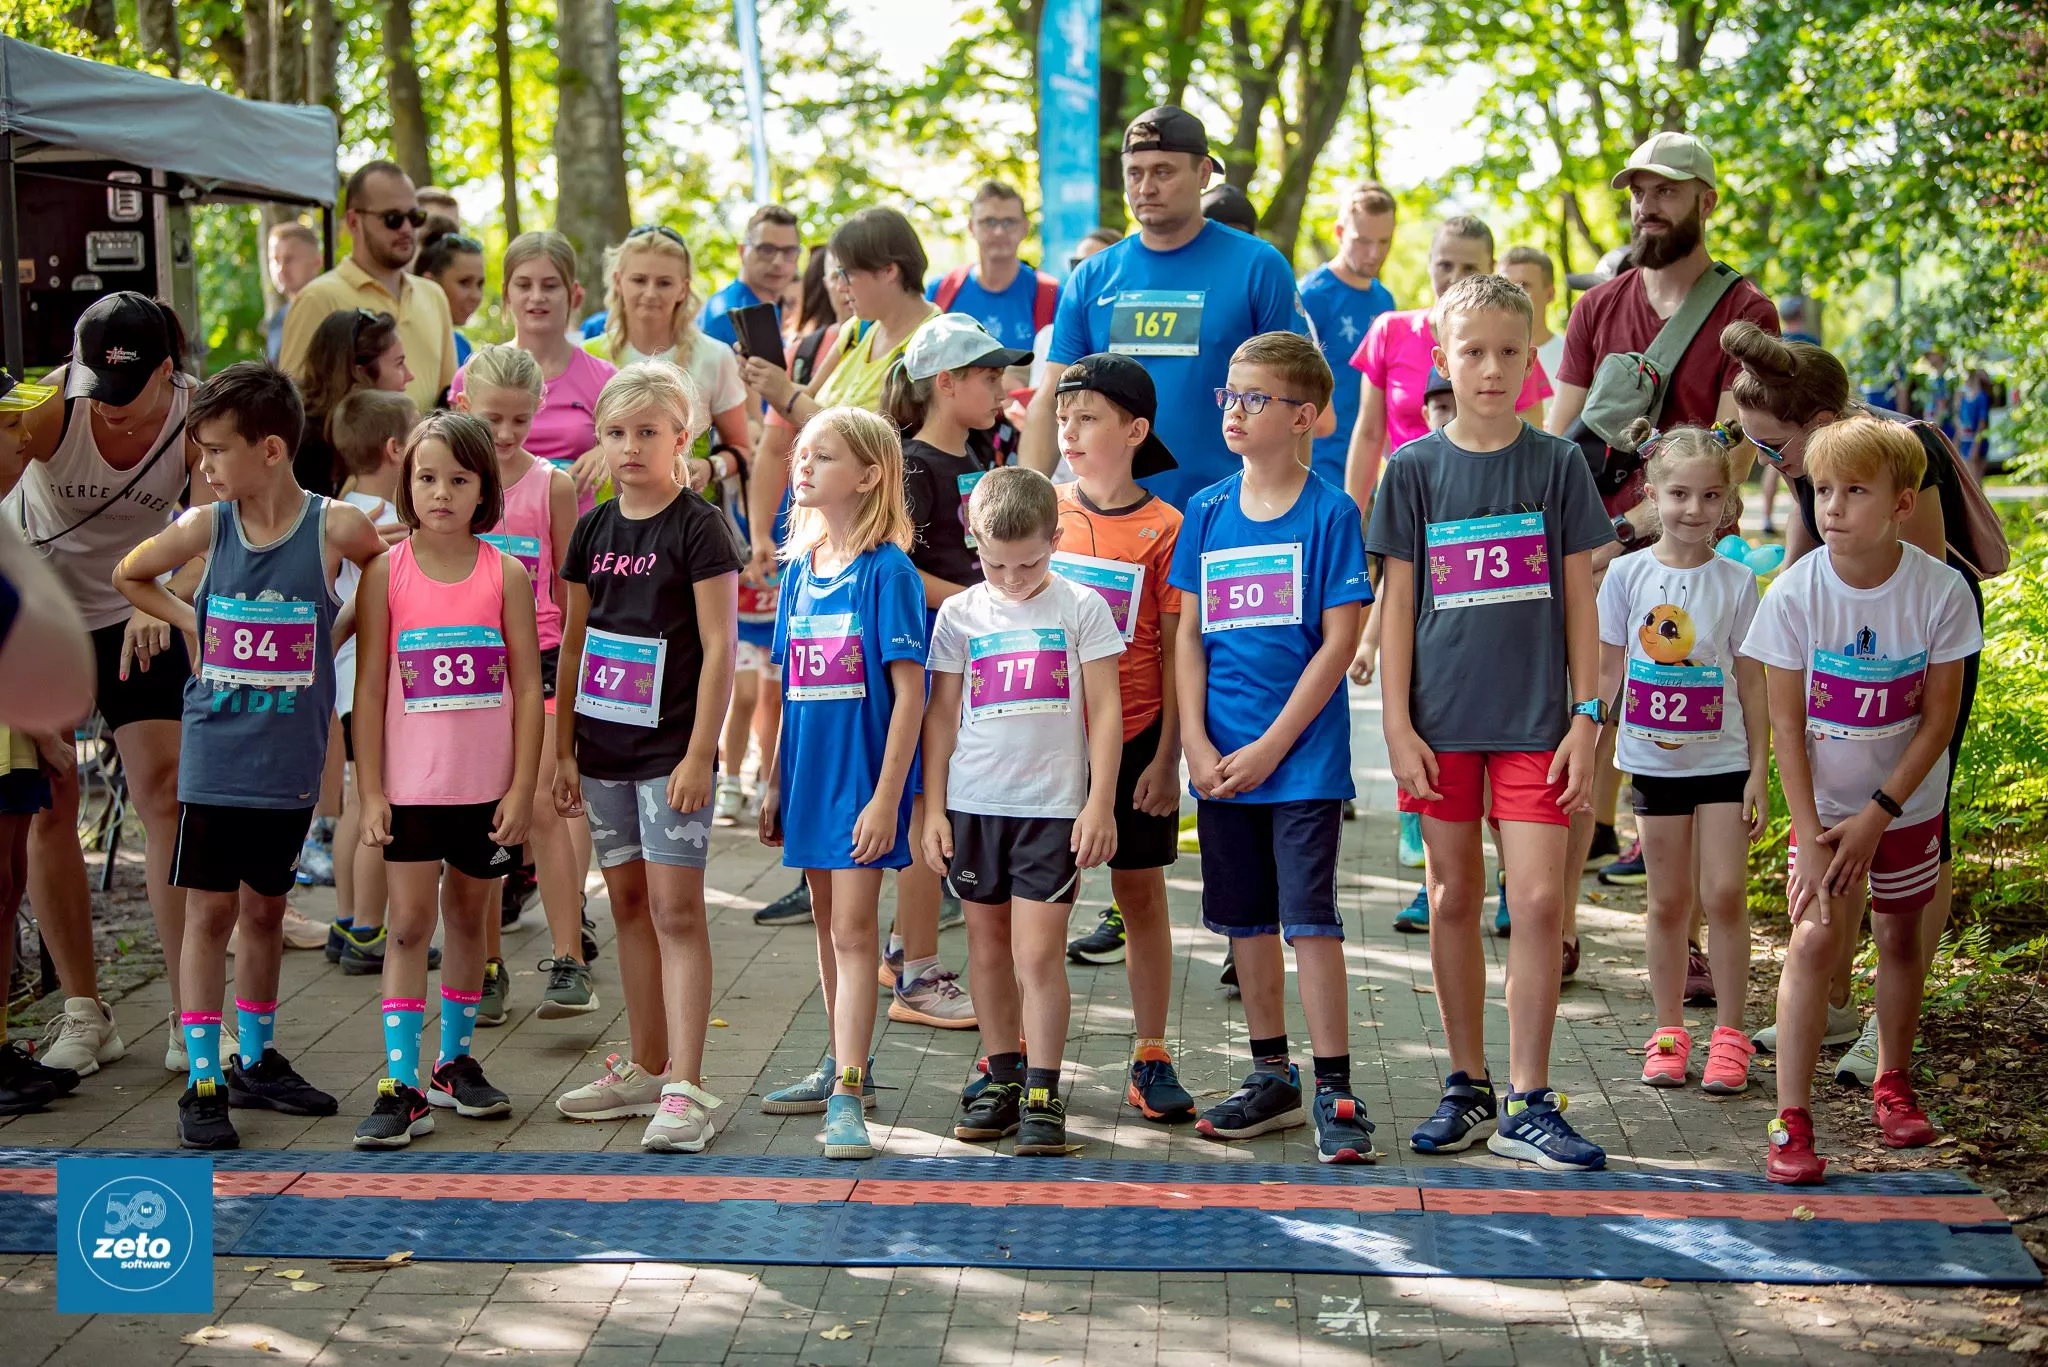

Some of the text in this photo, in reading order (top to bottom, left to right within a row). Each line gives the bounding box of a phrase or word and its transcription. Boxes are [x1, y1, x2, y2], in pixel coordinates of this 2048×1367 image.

[1135, 312, 1177, 337] 167
[591, 552, 657, 576] SERIO?
[1466, 546, 1510, 581] 73
[1229, 583, 1264, 610] 50
[233, 628, 278, 662] 84
[795, 644, 826, 677] 75
[432, 653, 476, 687] 83
[593, 664, 626, 691] 47
[997, 657, 1036, 692] 77
[211, 691, 297, 713] TIDE
[1649, 690, 1688, 723] 82
[1854, 687, 1889, 718] 71
